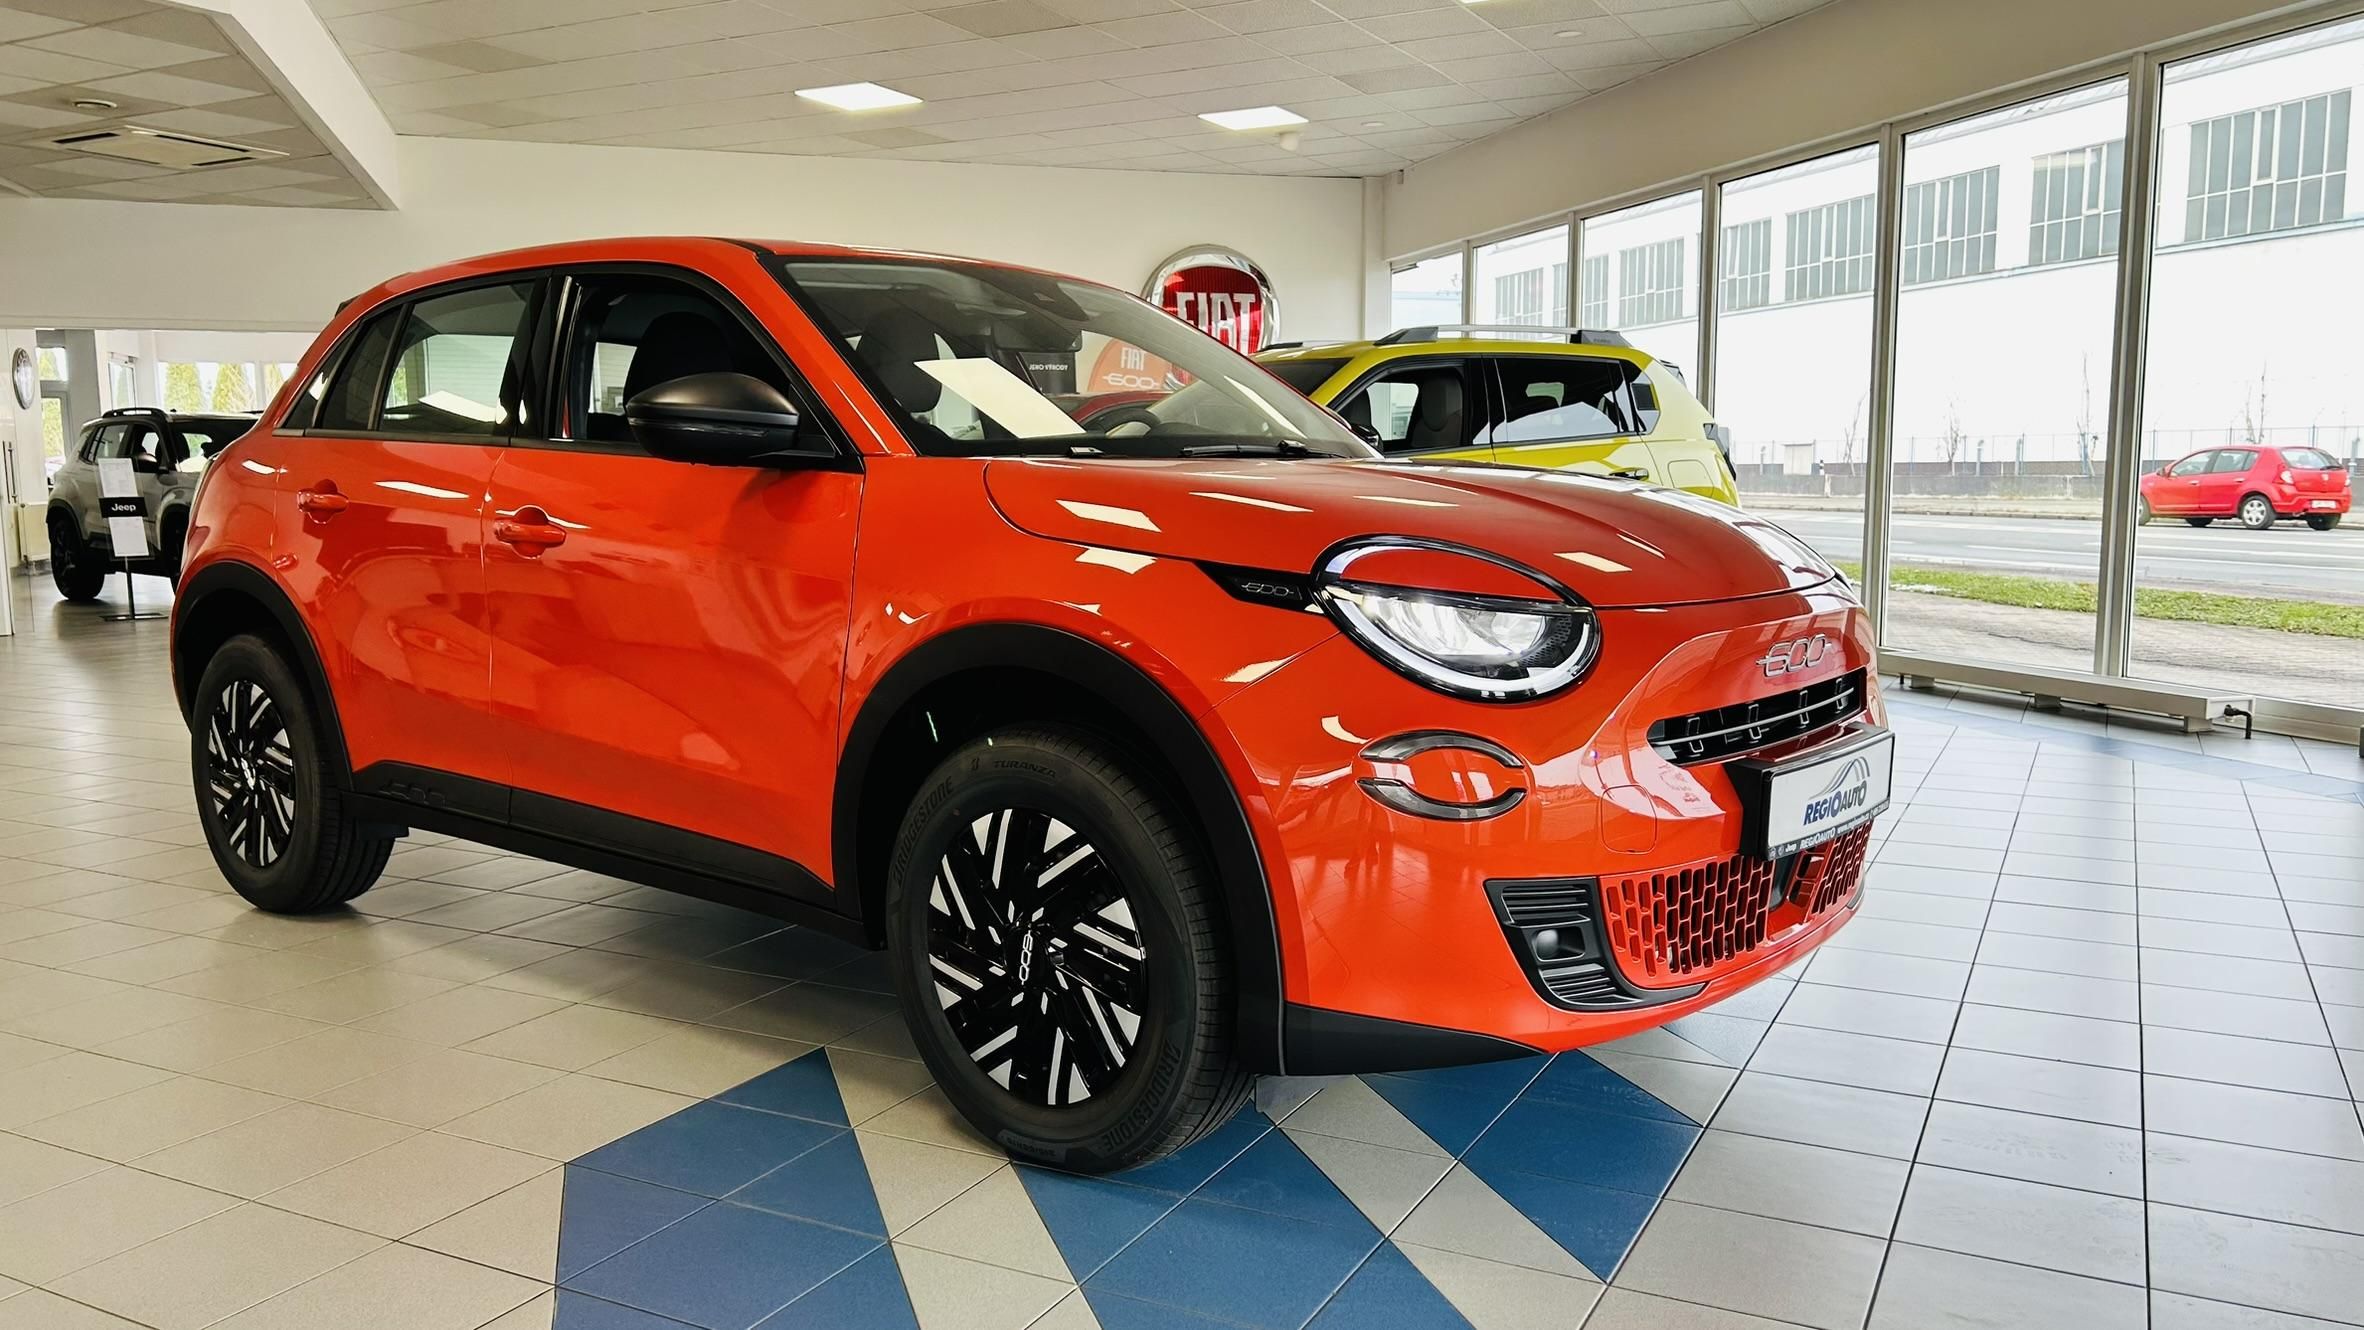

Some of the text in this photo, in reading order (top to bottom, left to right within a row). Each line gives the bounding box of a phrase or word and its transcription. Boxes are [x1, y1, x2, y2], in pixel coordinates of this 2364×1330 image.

[1120, 347, 1146, 371] FIAT
[1103, 372, 1159, 390] 600
[111, 503, 137, 513] Jeep
[1755, 633, 1832, 678] 600
[993, 759, 1056, 778] TURANZA
[1803, 780, 1868, 826] REGIOAUTO
[892, 775, 955, 888] BRIDGESTONE
[1102, 1038, 1181, 1152] BRIDGESTONE
